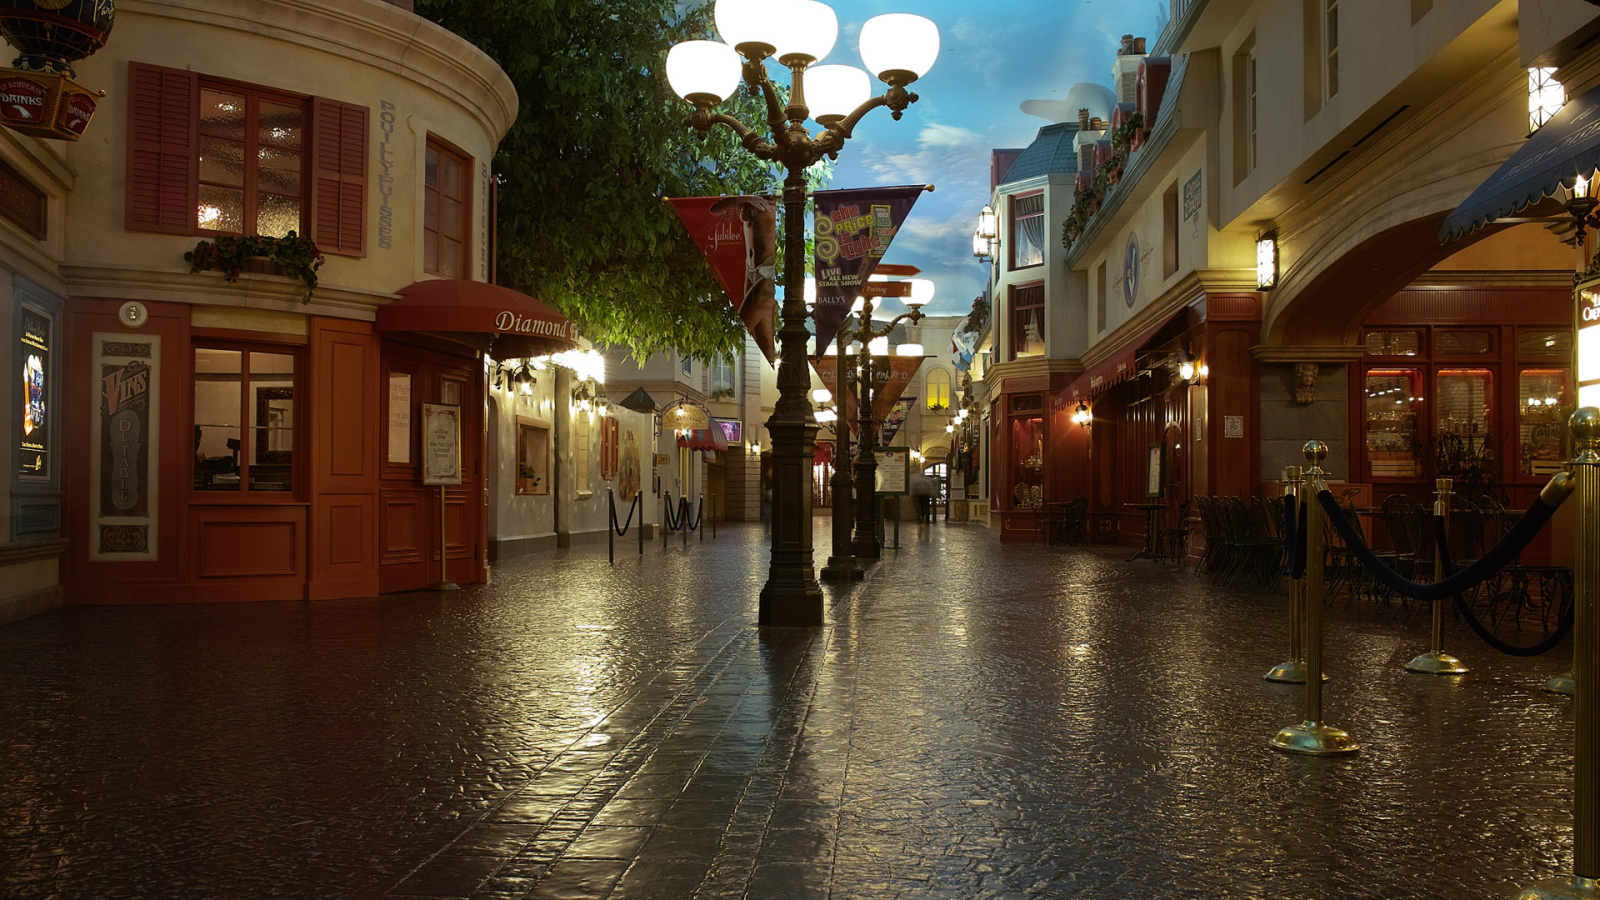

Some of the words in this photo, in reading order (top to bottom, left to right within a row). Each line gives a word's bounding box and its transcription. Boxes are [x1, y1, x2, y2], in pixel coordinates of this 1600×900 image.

[0, 93, 43, 107] DRINKS
[830, 205, 860, 223] the
[820, 267, 841, 280] LIVE
[818, 295, 846, 304] BALLY'S
[496, 310, 569, 338] Diamond
[101, 368, 148, 416] VINS
